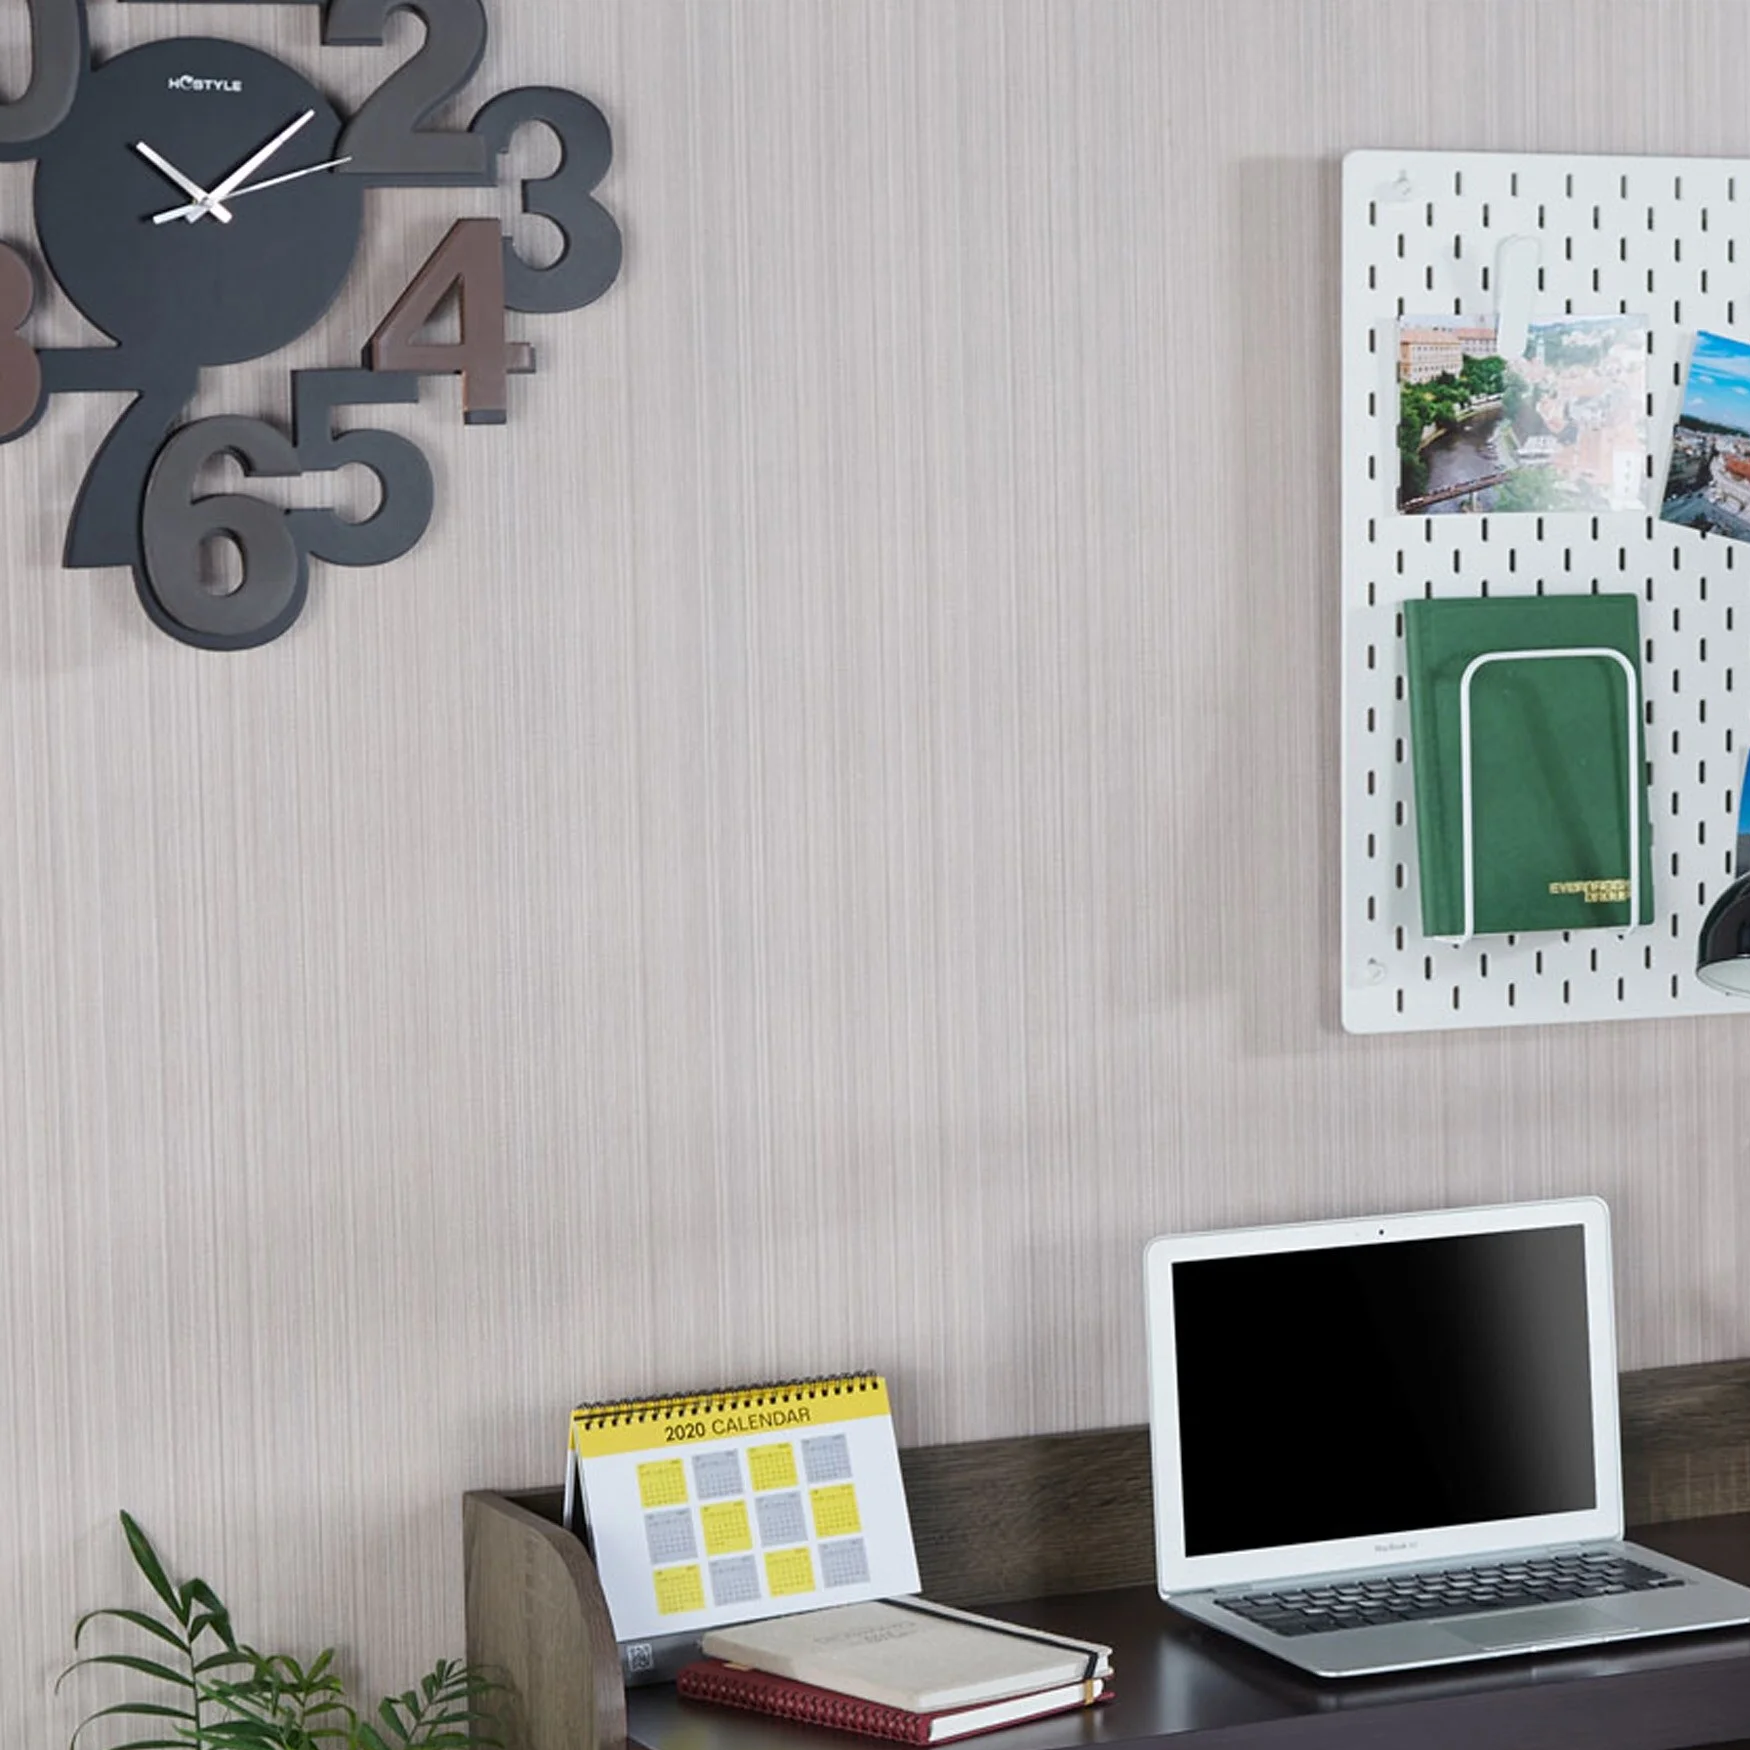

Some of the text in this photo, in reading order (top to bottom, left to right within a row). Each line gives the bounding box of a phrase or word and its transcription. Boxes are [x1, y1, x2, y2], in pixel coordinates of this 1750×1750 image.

[361, 217, 535, 424] 4
[133, 414, 309, 651] 6
[664, 1407, 811, 1442] 2020 CALENDAR
